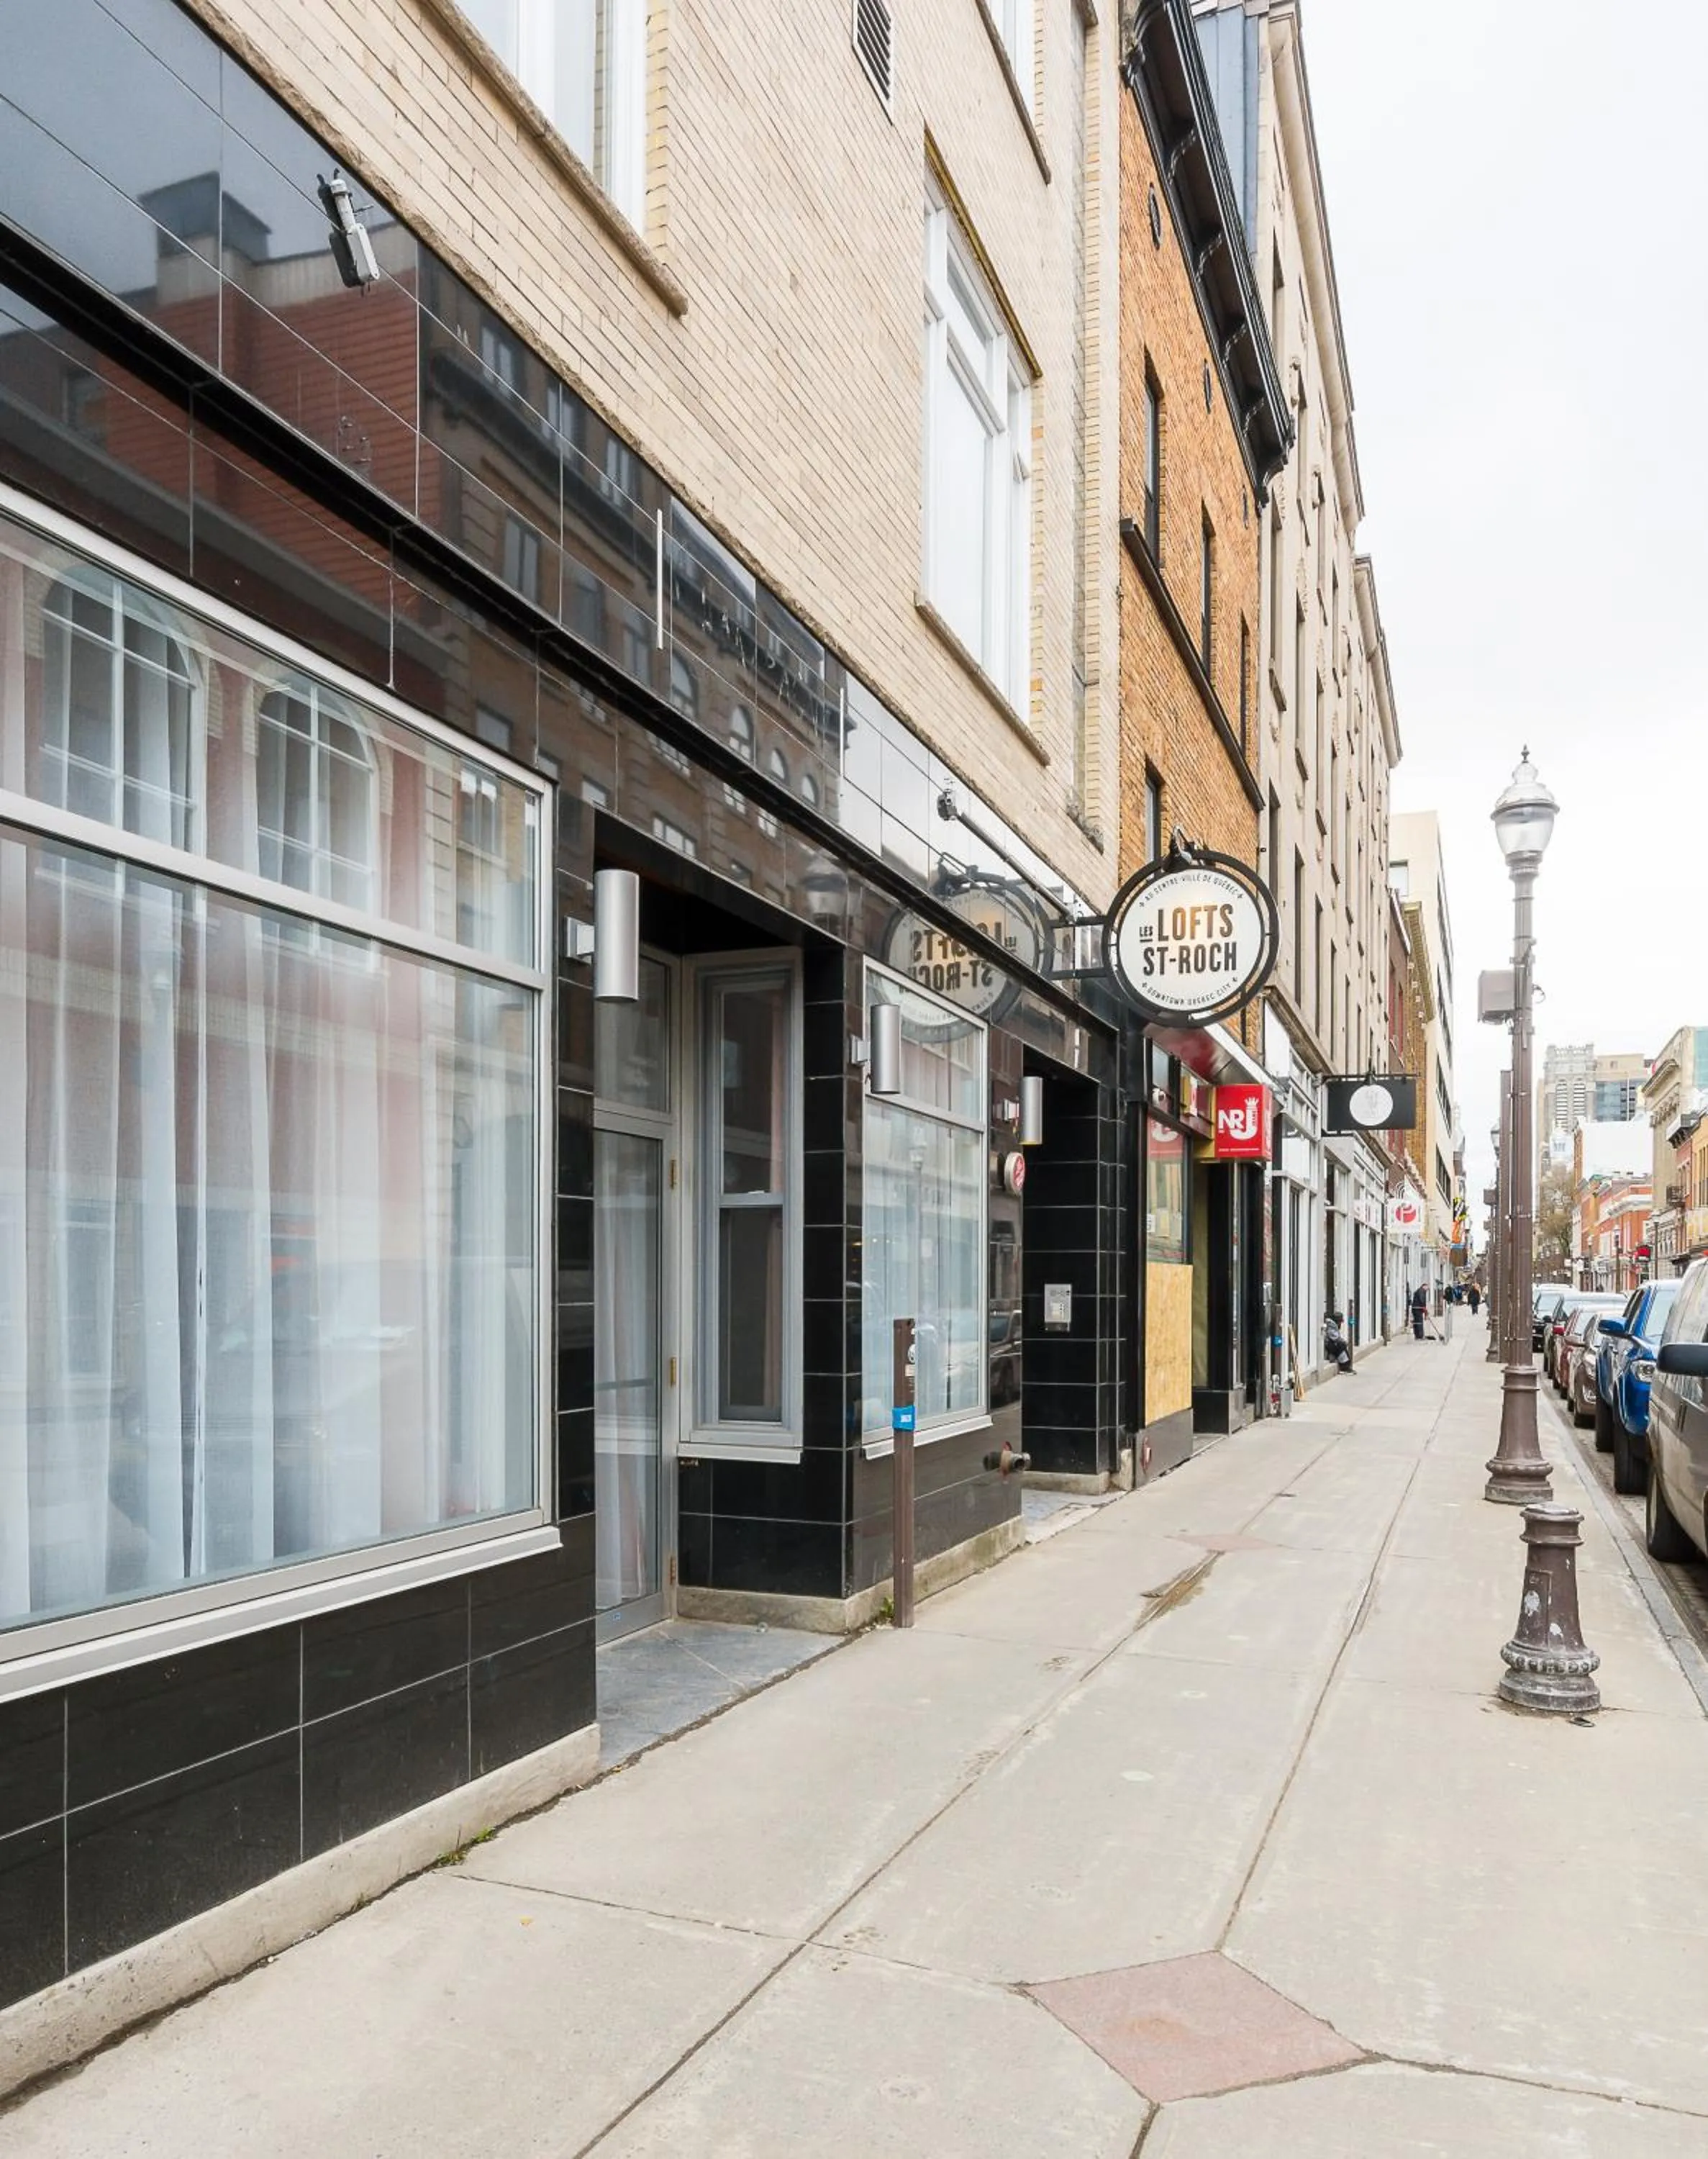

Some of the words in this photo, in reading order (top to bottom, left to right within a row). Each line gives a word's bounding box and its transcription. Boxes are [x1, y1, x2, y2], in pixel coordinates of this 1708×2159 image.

[1139, 926, 1153, 937] LES
[1158, 903, 1234, 941] LOFTS
[1143, 941, 1237, 976] ST-ROCH
[1218, 1099, 1258, 1141] NRJ
